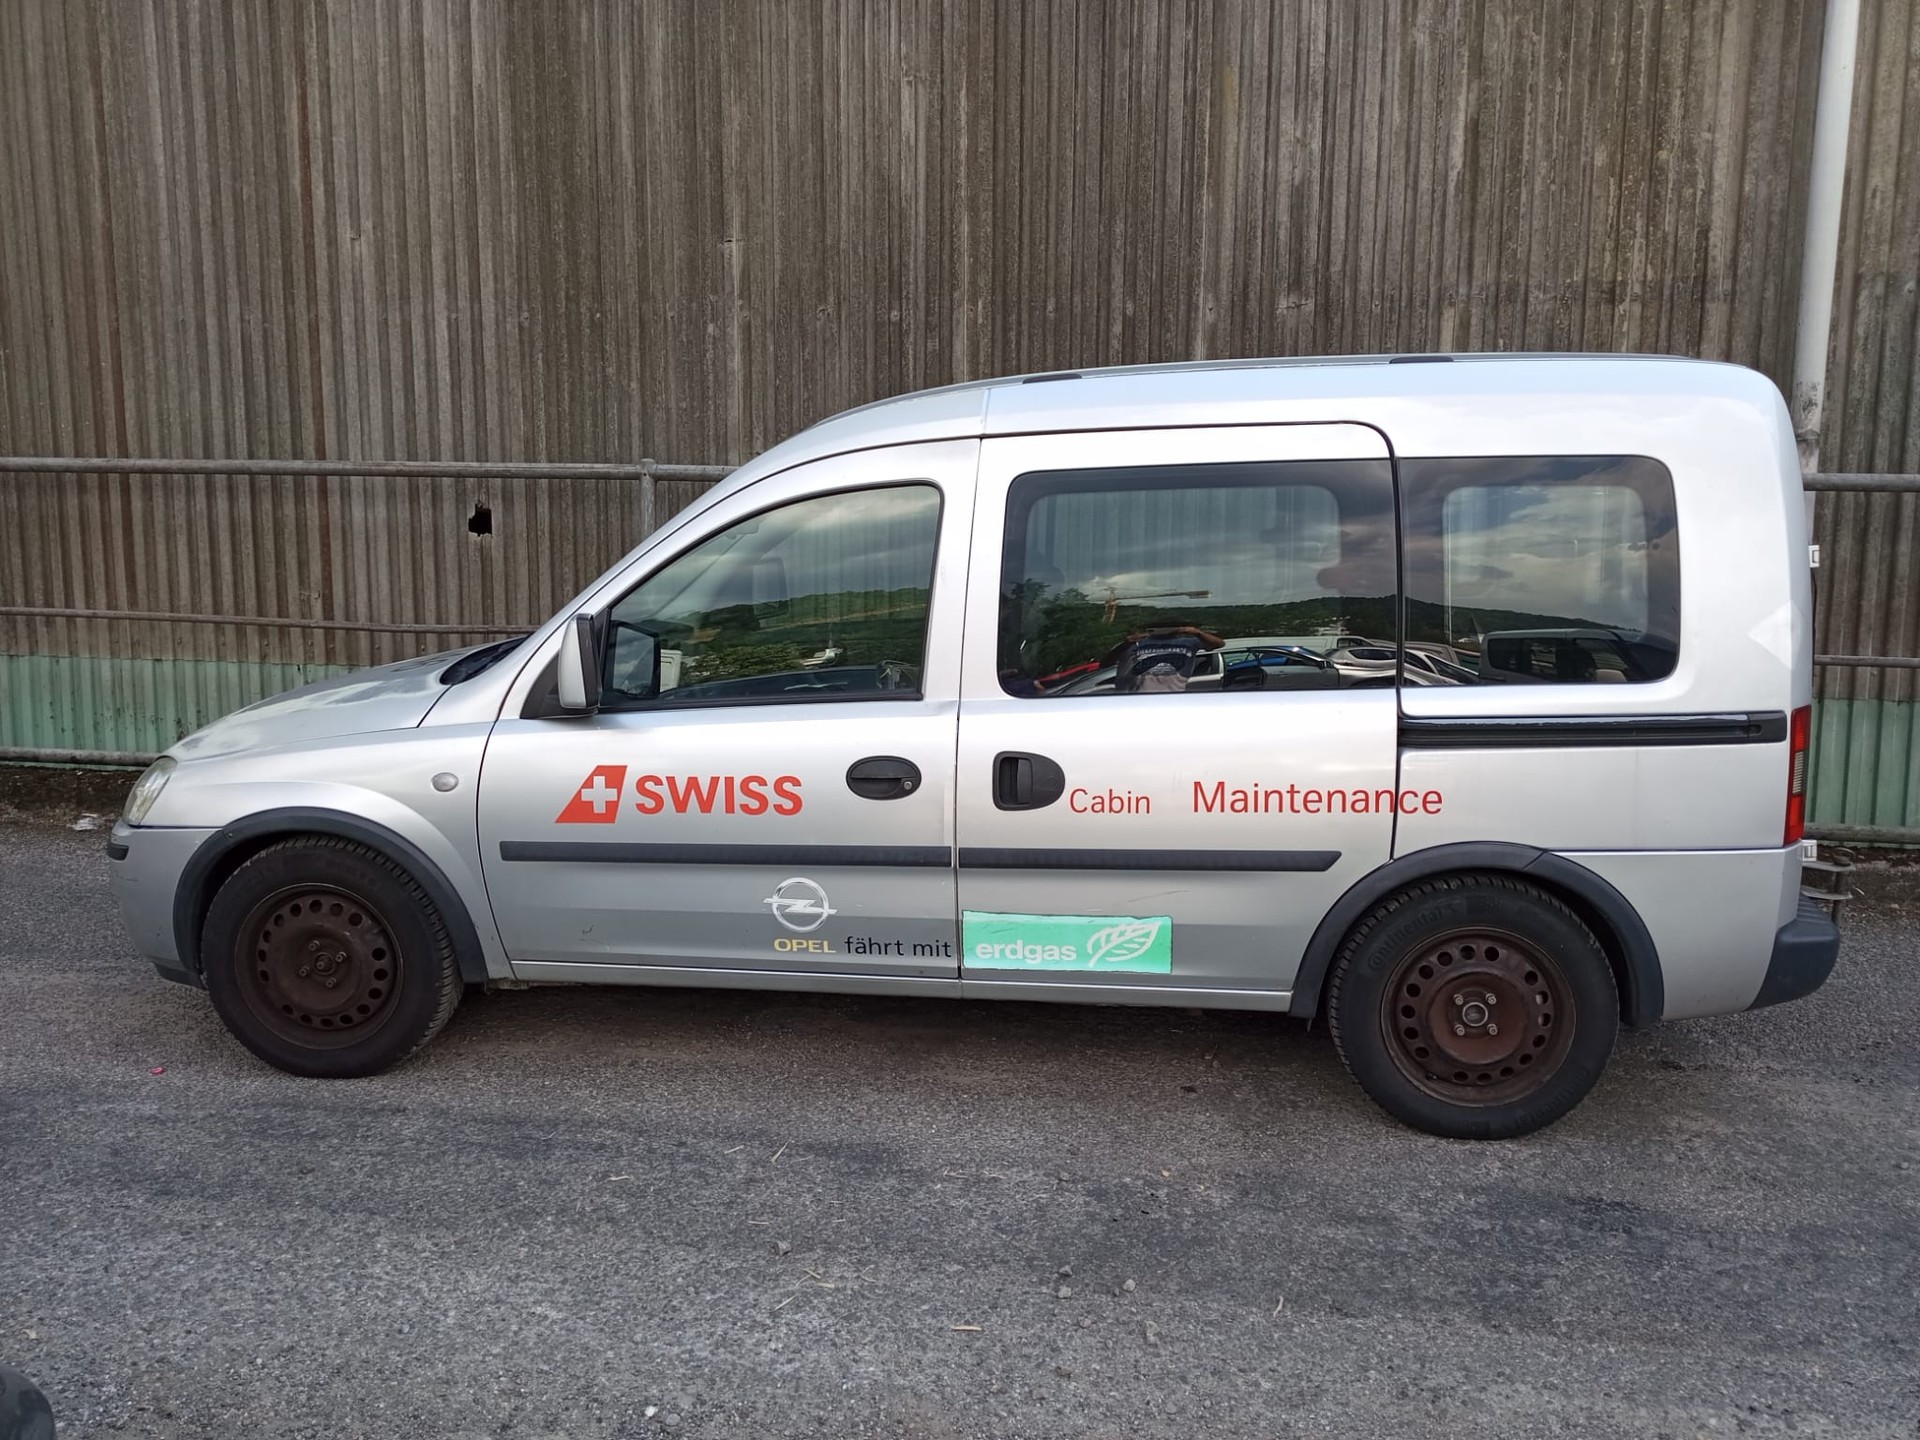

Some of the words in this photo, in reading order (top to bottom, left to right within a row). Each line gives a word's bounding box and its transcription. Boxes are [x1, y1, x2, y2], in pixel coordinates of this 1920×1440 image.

[635, 775, 803, 816] SWISS
[1069, 788, 1151, 814] Cabin
[1192, 781, 1443, 815] Maintenance
[773, 938, 836, 953] OPEL
[844, 936, 904, 955] fährt
[912, 939, 952, 958] mit
[975, 941, 1077, 964] erdgas
